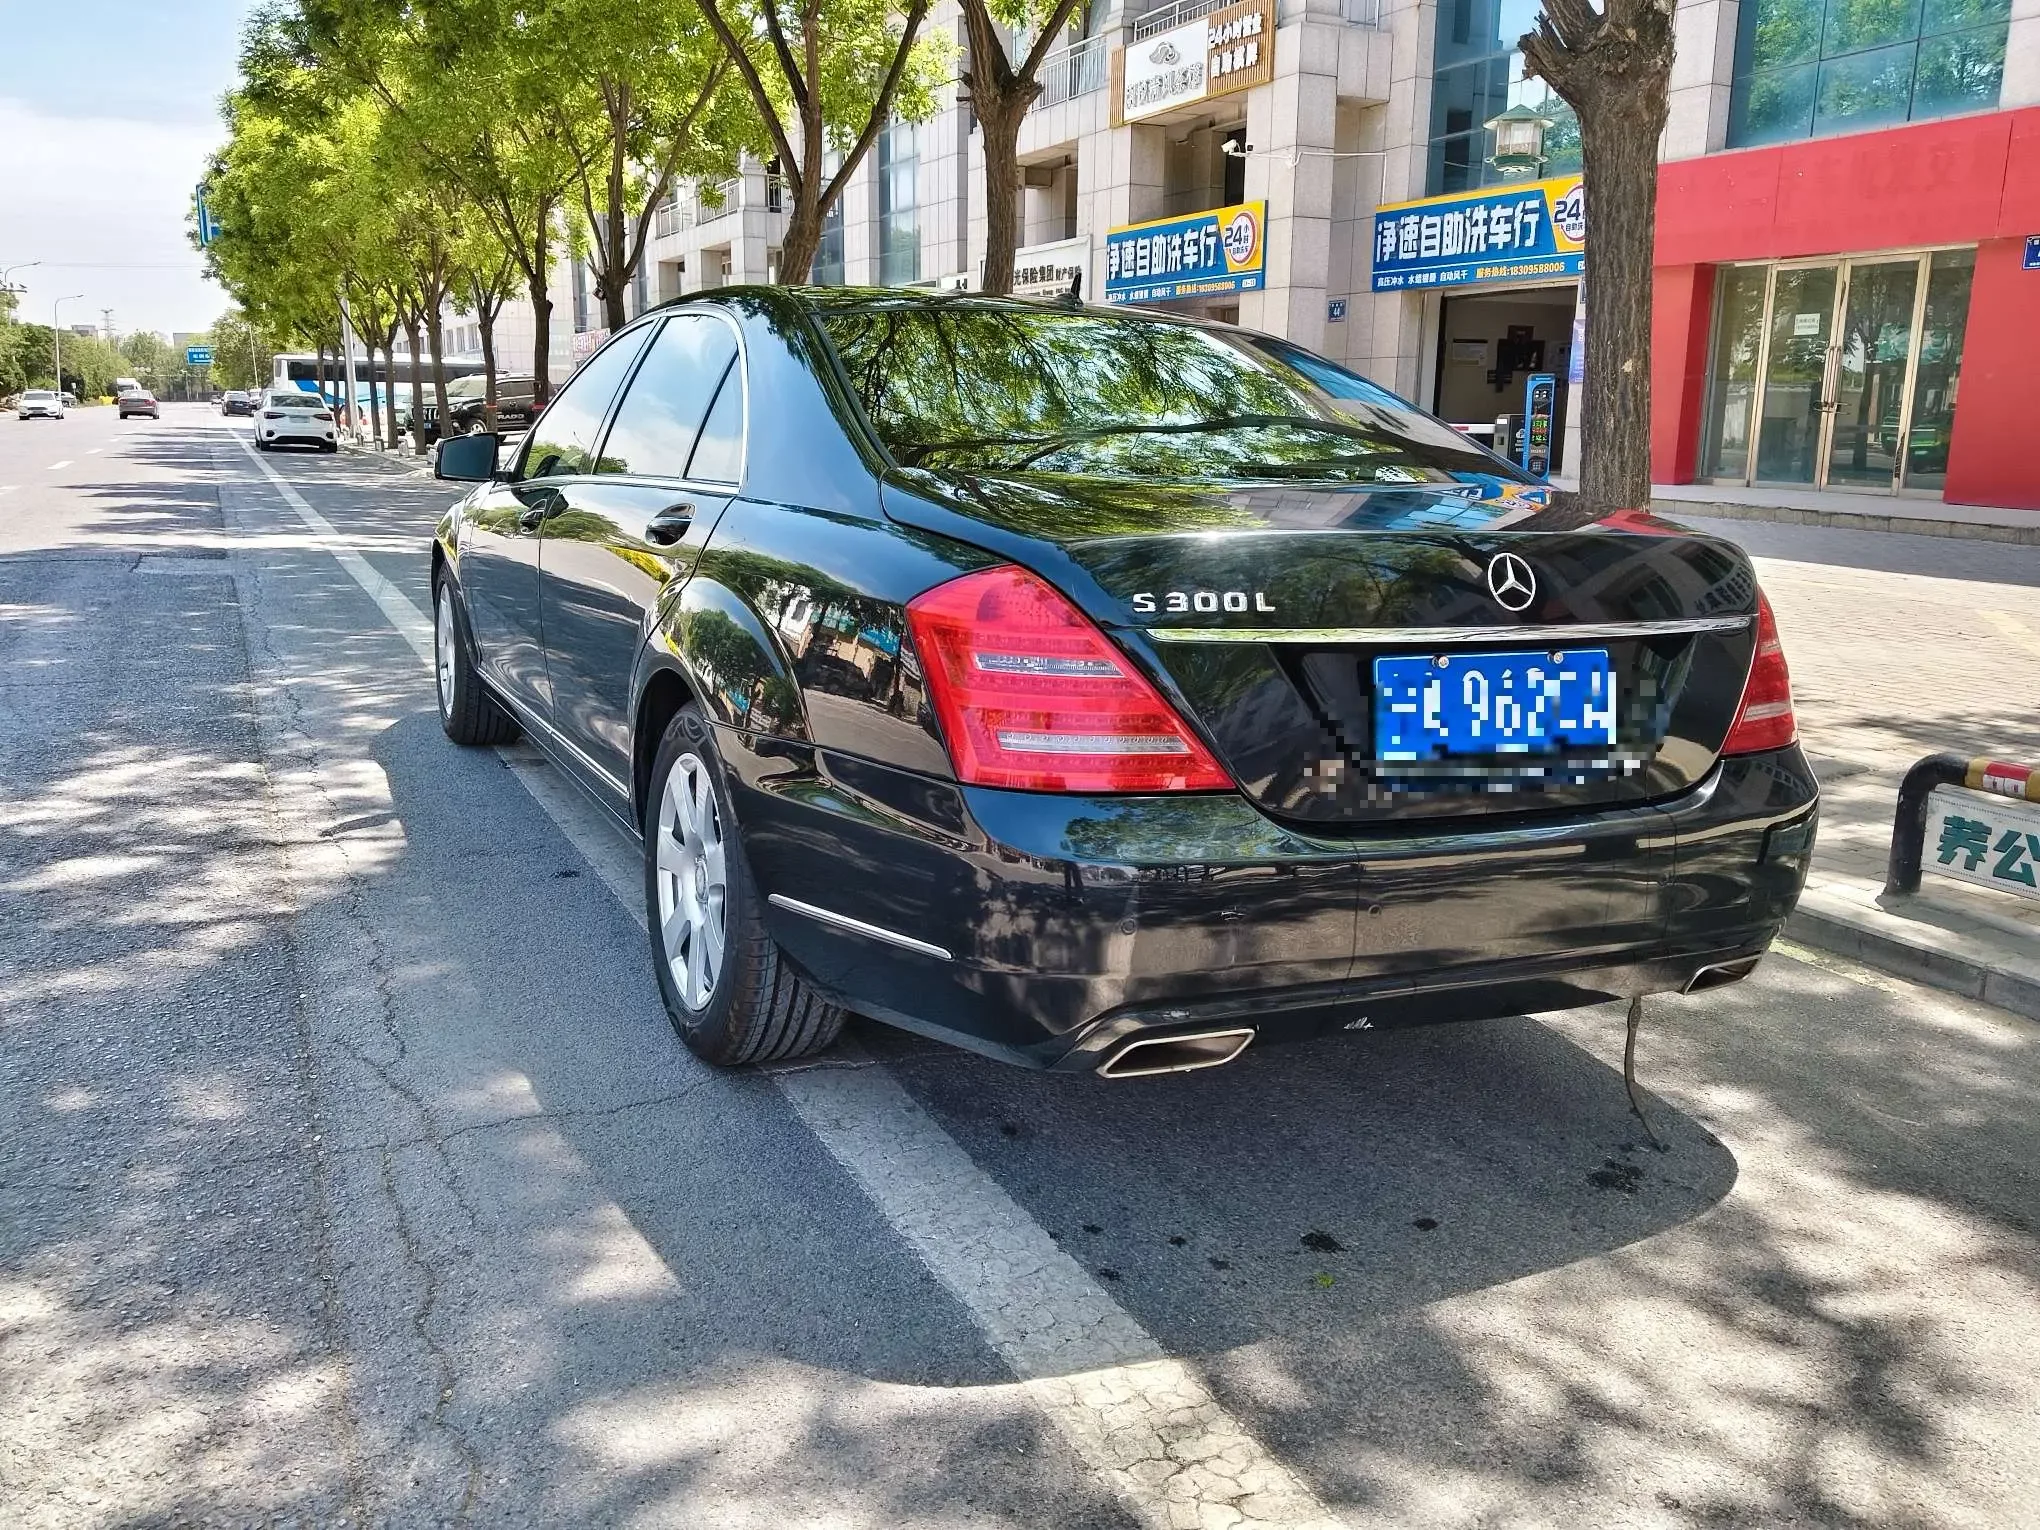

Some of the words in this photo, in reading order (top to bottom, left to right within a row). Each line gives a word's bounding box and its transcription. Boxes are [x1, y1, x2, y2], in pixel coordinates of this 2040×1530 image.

[1376, 199, 1541, 263] 净速自助洗车行
[1554, 198, 1580, 223] 24
[1107, 224, 1217, 280] 净速自助洗车行
[1440, 269, 1468, 282] 自动风干
[1937, 815, 2040, 888] 养公
